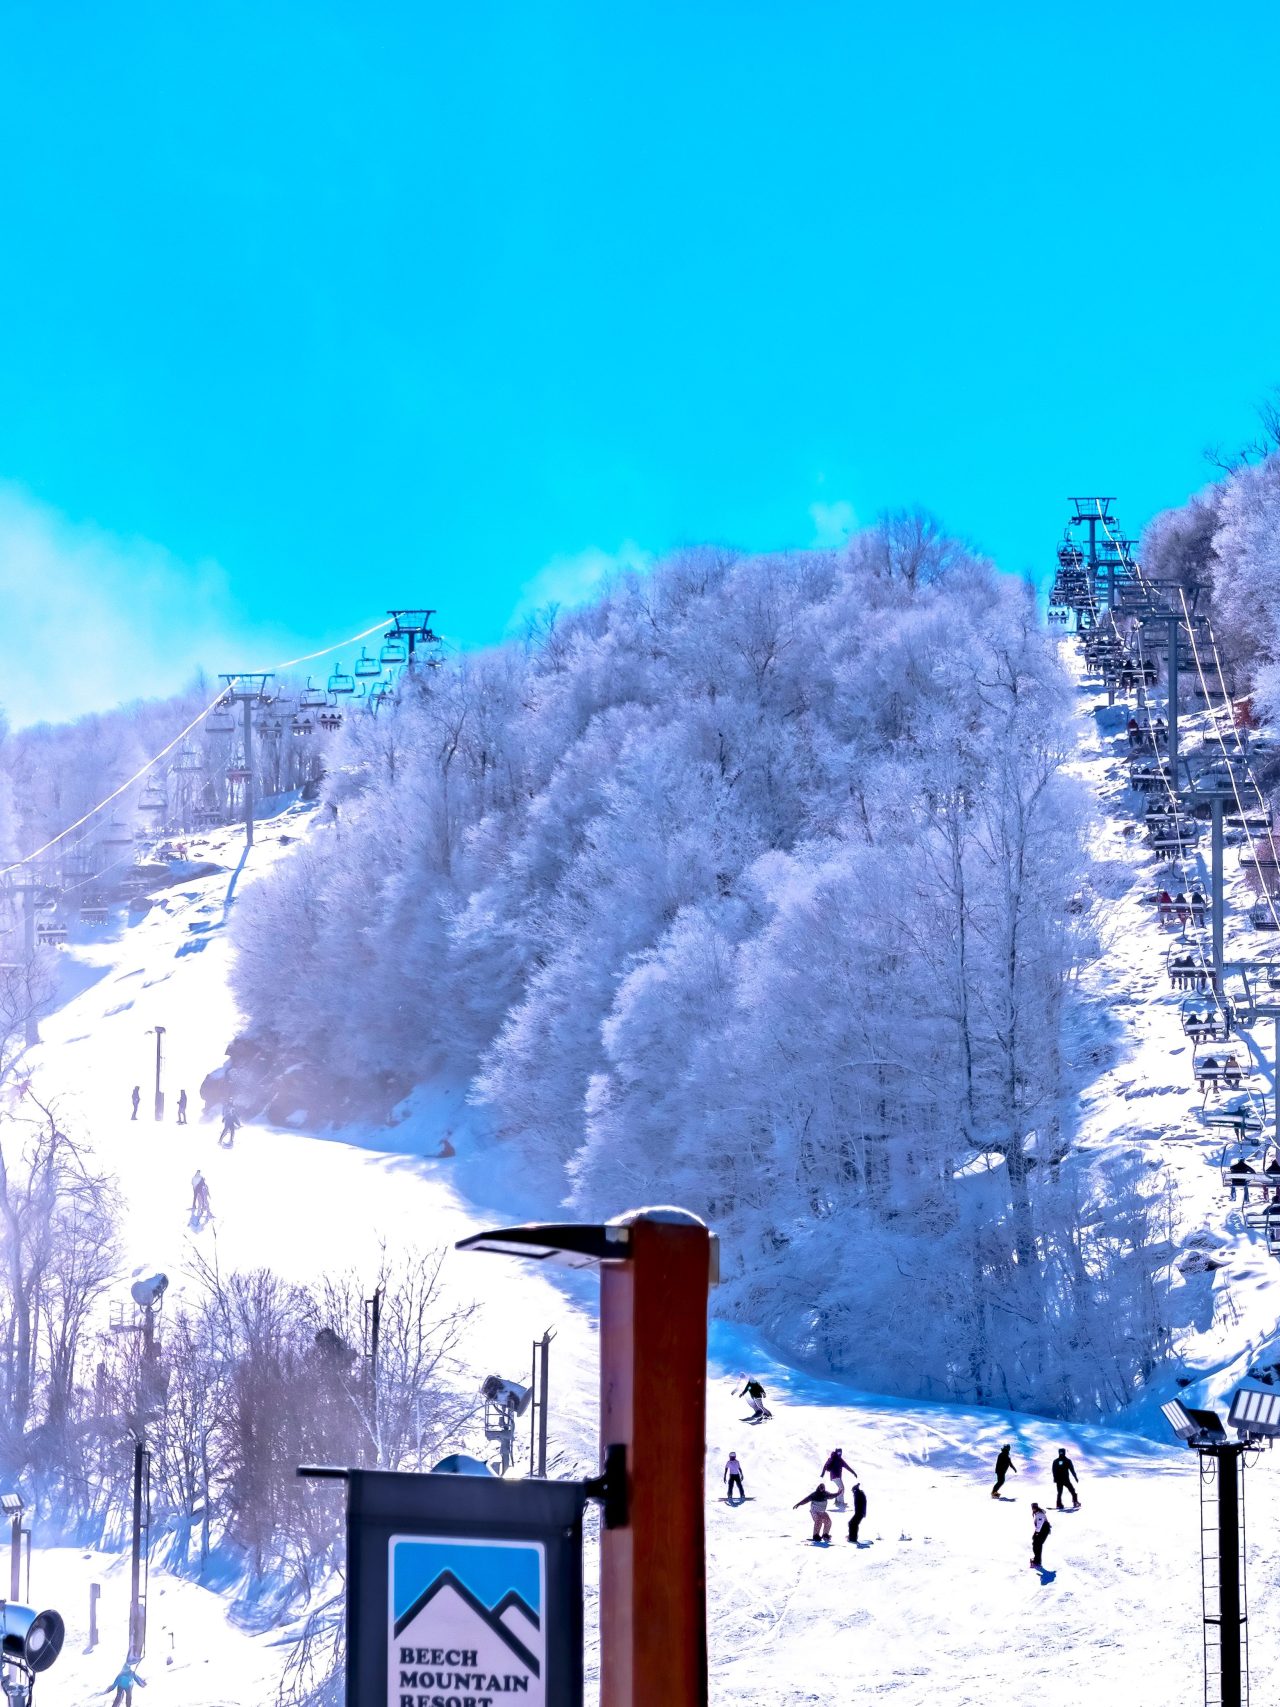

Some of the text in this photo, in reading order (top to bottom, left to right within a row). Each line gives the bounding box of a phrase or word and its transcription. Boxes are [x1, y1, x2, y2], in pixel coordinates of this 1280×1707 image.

[399, 1647, 478, 1667] BEECH
[399, 1670, 529, 1692] MOUNTAIN
[399, 1694, 493, 1707] RESORT
